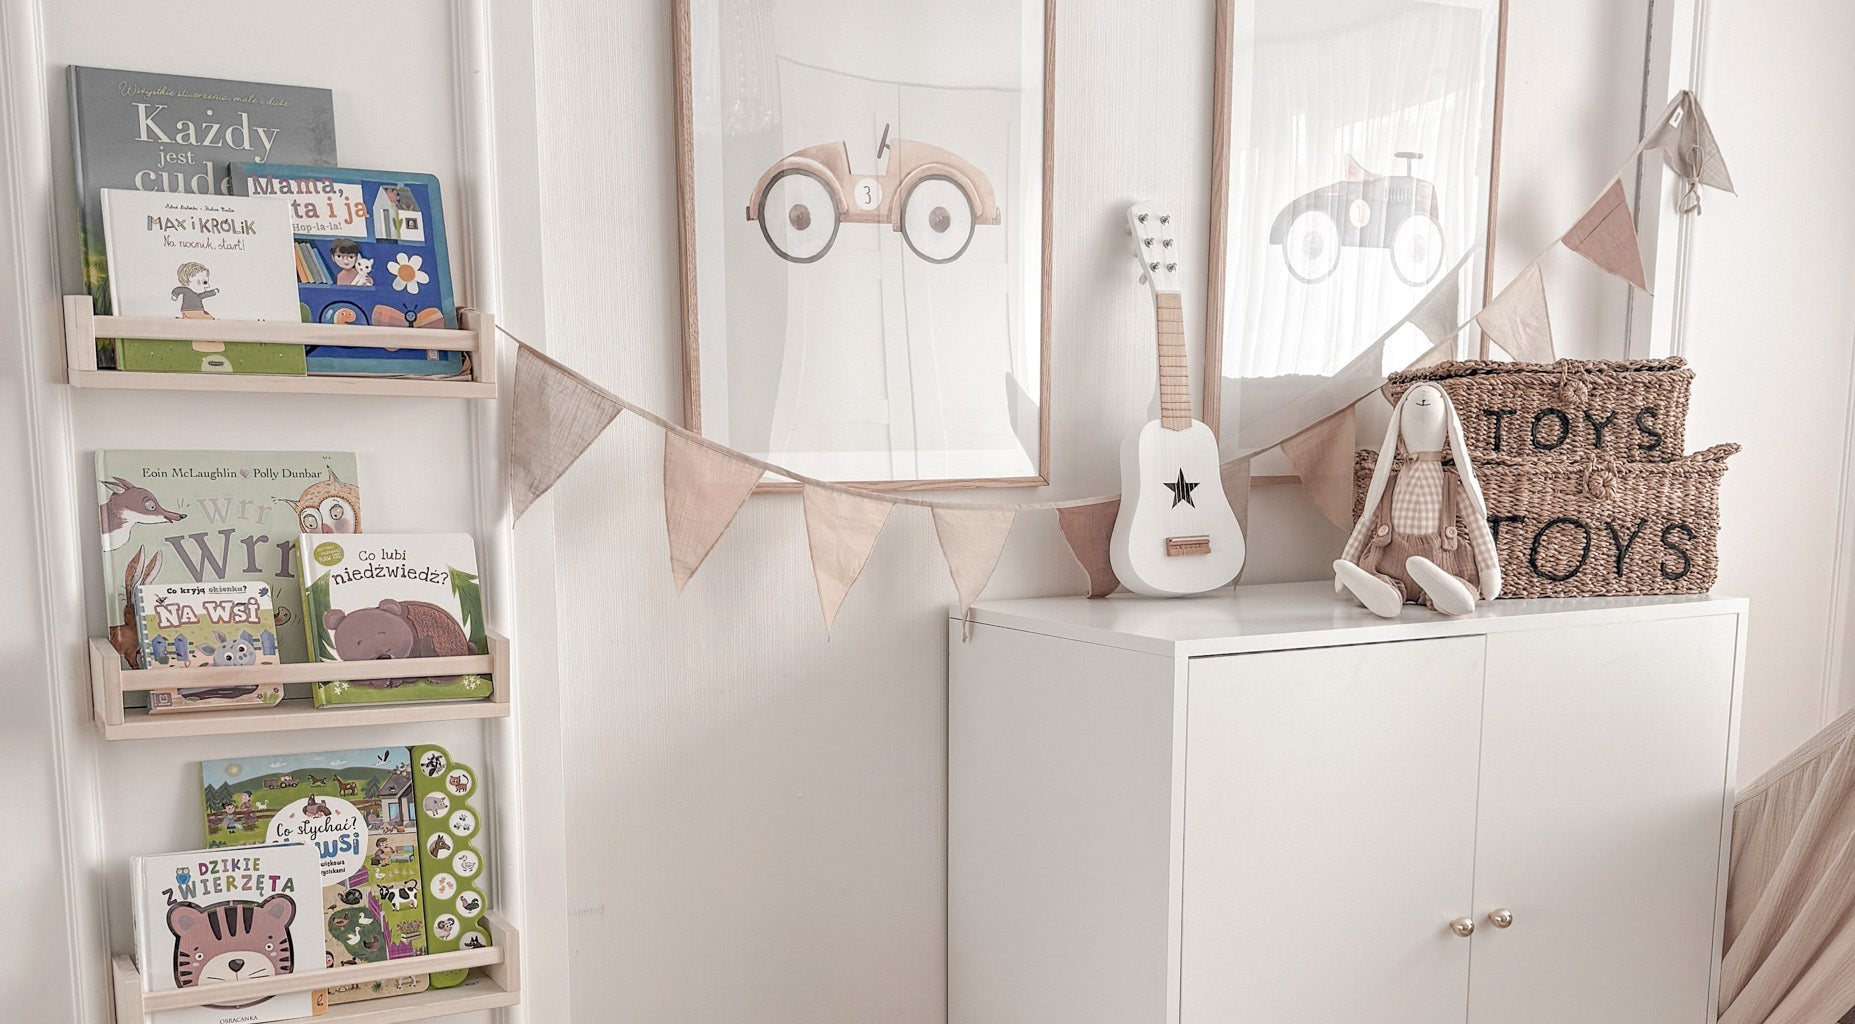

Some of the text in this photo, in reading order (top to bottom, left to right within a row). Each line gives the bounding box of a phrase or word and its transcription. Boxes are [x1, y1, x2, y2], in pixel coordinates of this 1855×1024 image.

[132, 103, 280, 164] Każdy
[158, 146, 195, 168] jest
[248, 173, 344, 198] Mama,
[863, 185, 872, 204] 3
[291, 195, 370, 225] ta i ja
[146, 215, 186, 232] MAX
[292, 221, 343, 234] Hop-la-la!
[163, 235, 177, 248] Na
[217, 237, 246, 252] start!
[1482, 405, 1664, 453] TOYS
[142, 467, 323, 481] Eoin McLaughlin Polly Dunbar
[195, 497, 273, 526] Wrr
[164, 528, 297, 583] Wrr
[358, 550, 376, 562] Co
[381, 548, 407, 561] lubi
[1487, 516, 1697, 582] TOYS
[331, 562, 449, 586] niedźwiedź?
[166, 585, 247, 596] Co kryją okienka?
[154, 602, 200, 629] NA
[276, 816, 357, 841] Co słychać?
[198, 857, 261, 876] DZIKIE
[162, 874, 296, 907] ZWIERZĘTA
